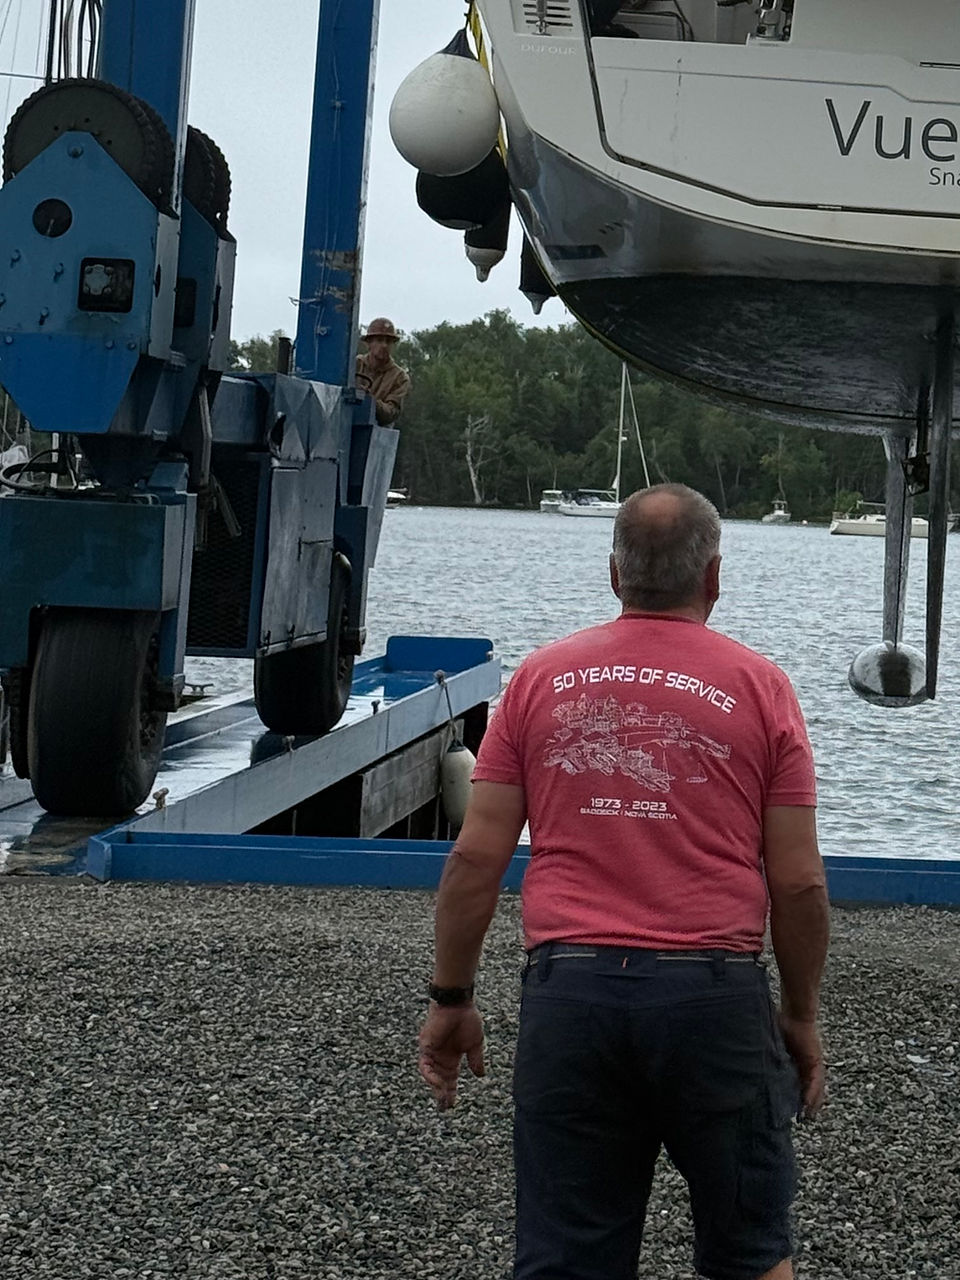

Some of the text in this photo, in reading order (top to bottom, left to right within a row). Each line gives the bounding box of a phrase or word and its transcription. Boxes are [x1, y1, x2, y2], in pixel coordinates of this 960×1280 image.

[824, 98, 959, 162] Vue
[552, 665, 738, 714] 50 YEARS OF SERVICE
[580, 807, 620, 816] BADDECK
[624, 810, 647, 818] NOVA
[647, 812, 678, 820] SCOTIA
[590, 797, 622, 809] 1973
[632, 800, 668, 812] 2023
